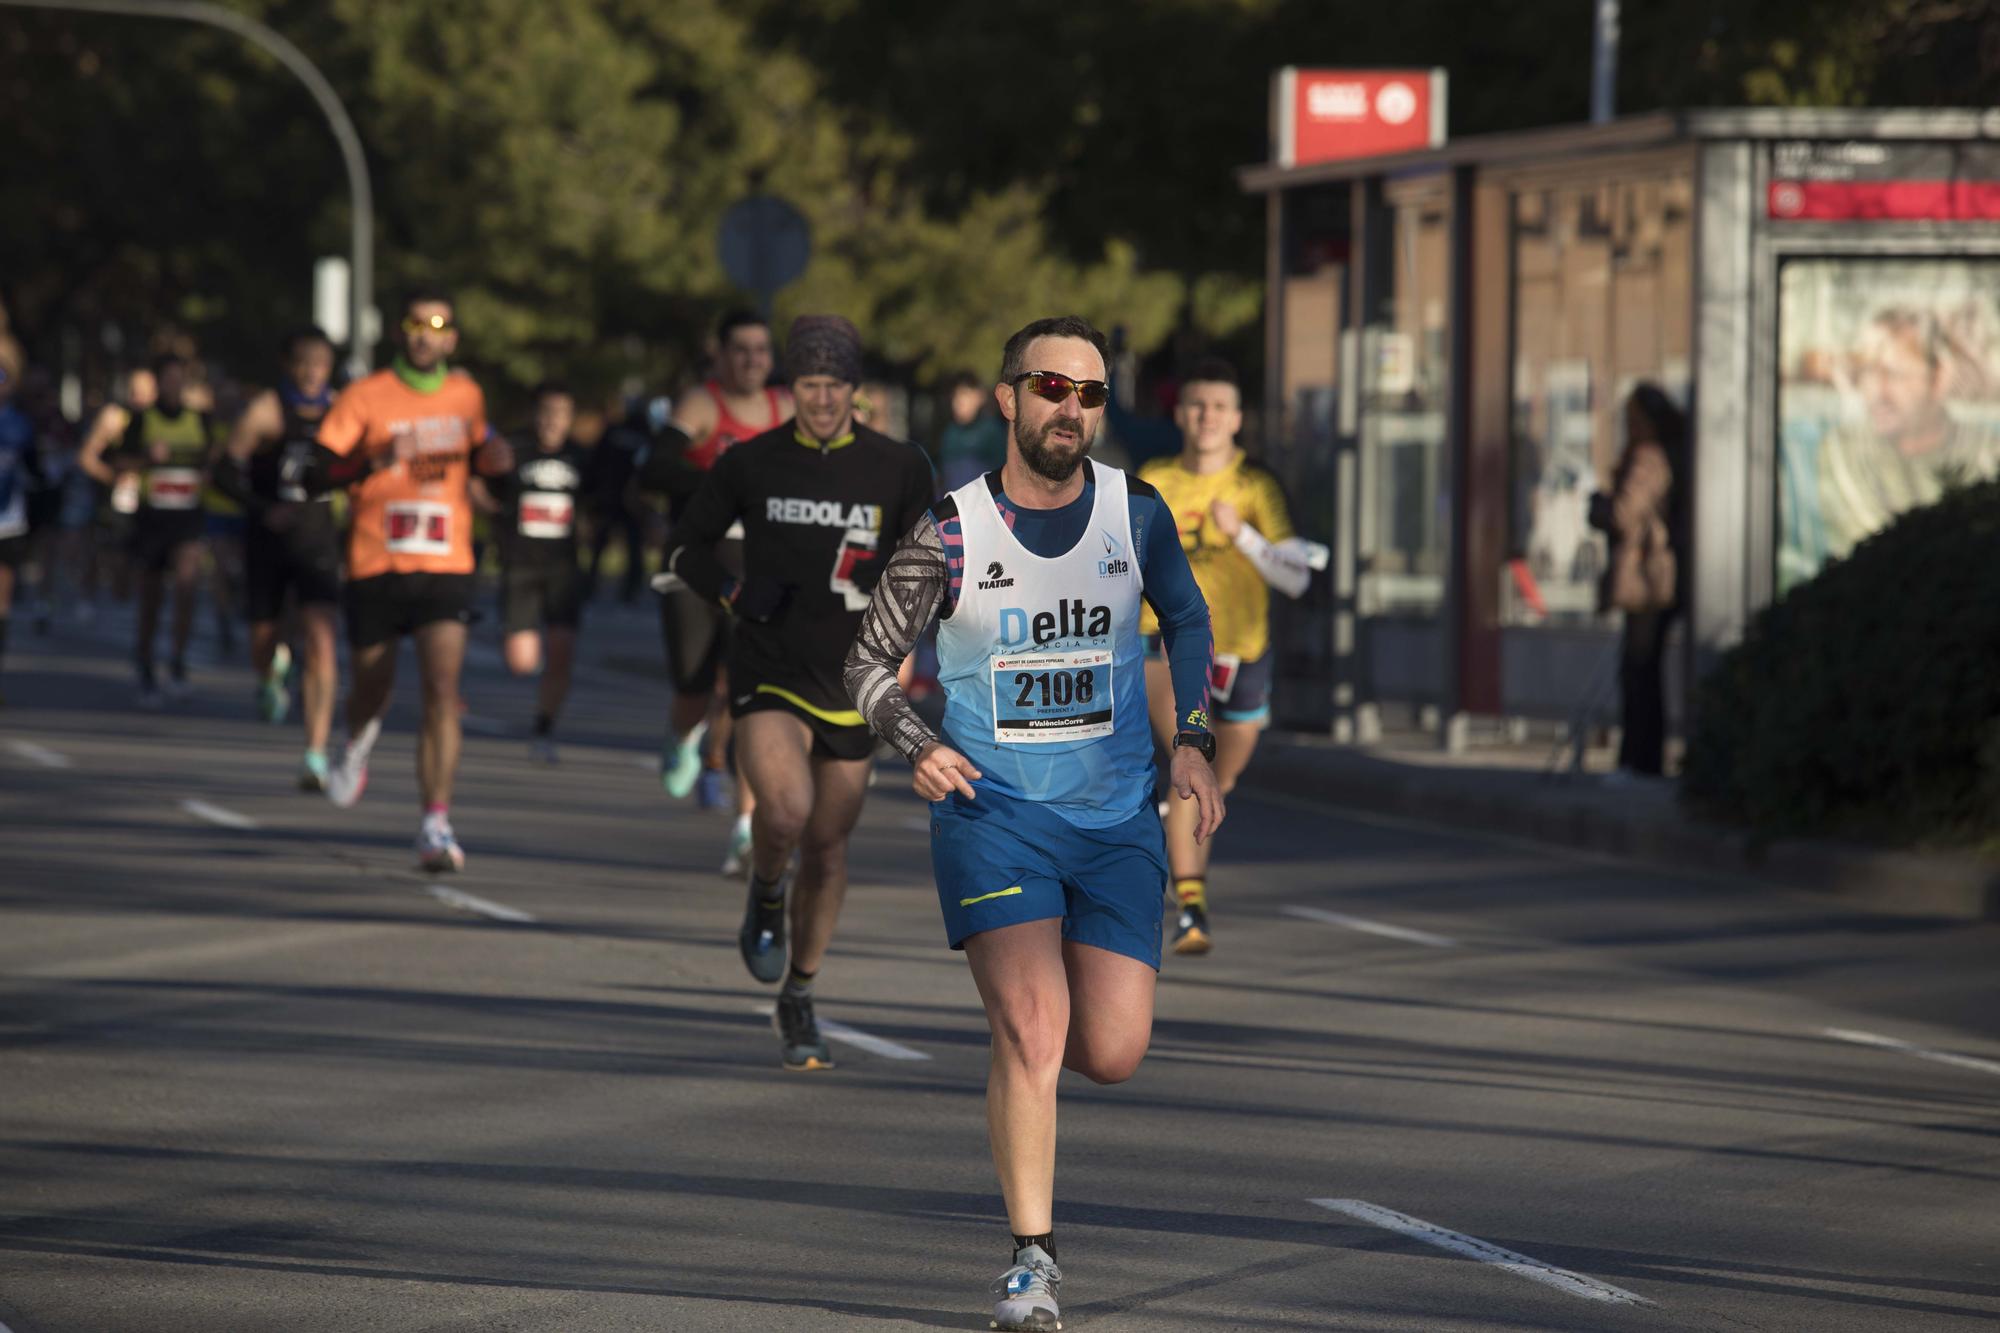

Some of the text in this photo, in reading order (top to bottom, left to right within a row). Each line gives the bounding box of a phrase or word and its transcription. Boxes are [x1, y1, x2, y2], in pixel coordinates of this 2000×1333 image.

[1098, 560, 1128, 575] Delta
[978, 578, 1014, 590] VIATOR
[1000, 599, 1111, 647] Delta
[1014, 670, 1094, 706] 2108
[1029, 718, 1084, 727] #ValènciaCorre
